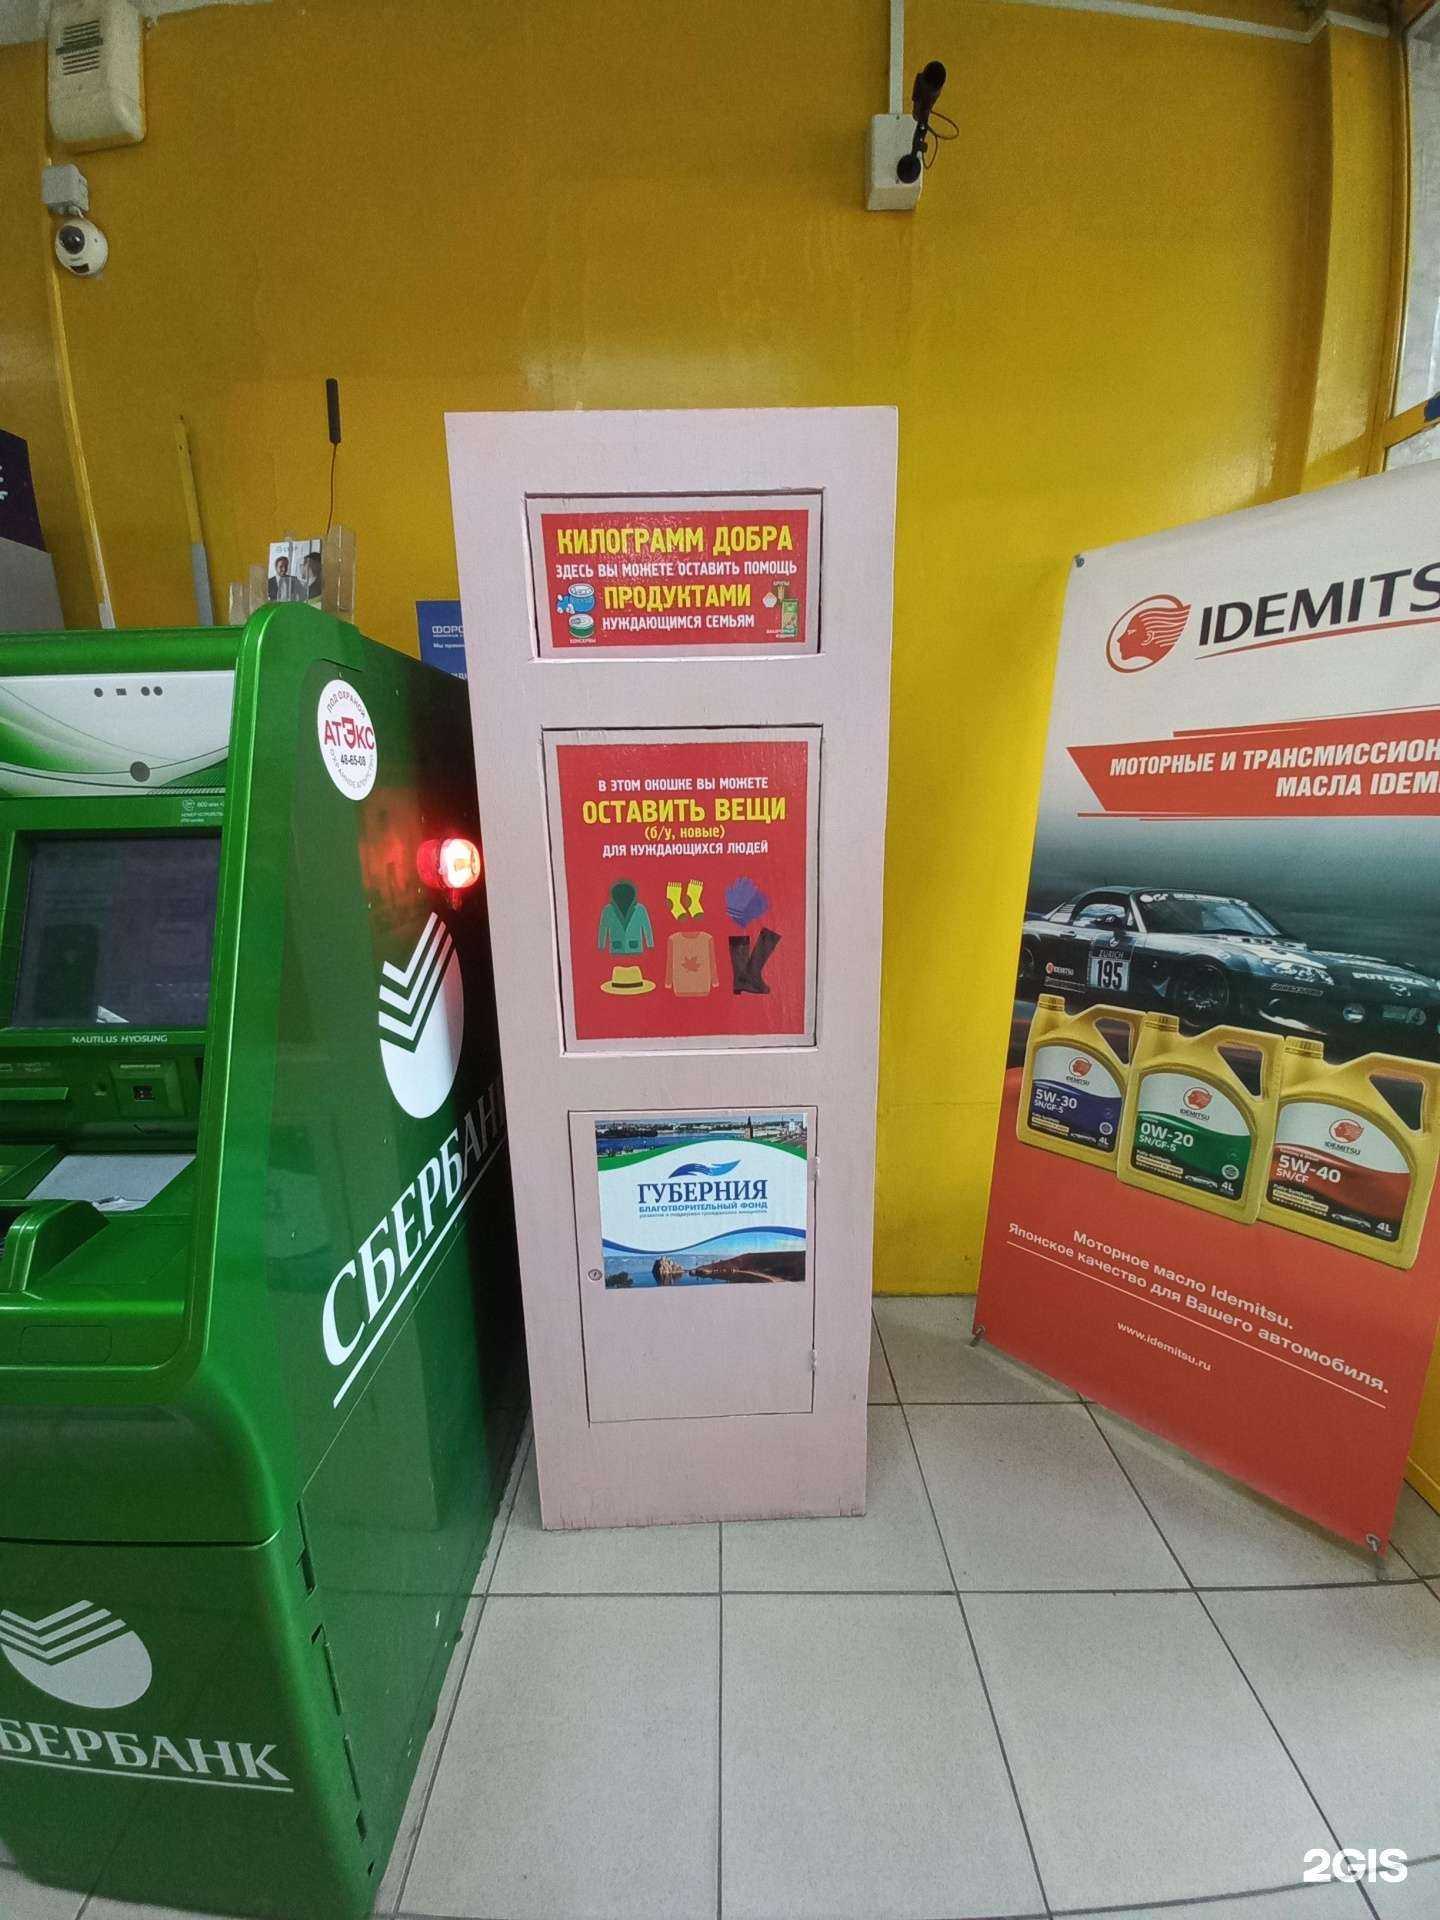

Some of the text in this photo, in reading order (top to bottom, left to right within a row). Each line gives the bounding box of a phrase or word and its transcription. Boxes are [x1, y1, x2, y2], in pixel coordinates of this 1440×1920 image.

[557, 525, 793, 556] КИЛОГРАММ ДОБРА
[556, 560, 798, 579] ЗДЕСЬ ВЫ МОЖЕТЕ ОСТАВИТЬ ПОМОЩЬ
[604, 584, 751, 612] ПРОДУКТАМИ
[1199, 562, 1440, 647] IDEMITS
[602, 614, 755, 632] НУЖДАЮЩИМСЯ СЕМЬЯМ
[323, 716, 375, 751] АТЭКС
[1109, 739, 1440, 777] МОТОРНЫЕ И ТРАНСМИССИОН
[598, 777, 769, 792] В ЭТОМ ОКОШКЕ ВЫ МОЖЕТЕ
[1276, 771, 1440, 797] МАСЛА IDEM
[582, 797, 786, 824] ОСТАВИТЬ ВЕЩИ
[644, 825, 725, 841] (б/у, новые)
[602, 840, 769, 858] ДЛЯ НУЖДАЮЩИХСЯ ЛЮДЕЙ
[1097, 960, 1123, 991] 195
[72, 1034, 168, 1044] NAUTILUS HYOSUNG
[1035, 1088, 1078, 1109] 5W-30
[1140, 1122, 1194, 1148] 0W-20
[1278, 1154, 1341, 1184] 5W-40
[637, 1179, 768, 1204] ГУБЕРНИЯ
[1221, 1180, 1235, 1192] 4L
[639, 1201, 768, 1213] БЛАГОТВОРИТЕЛЬНЫЙ ФОНД
[1376, 1221, 1393, 1233] 4L
[1073, 1230, 1293, 1331] Моторное масло Idemitsu.
[1008, 1222, 1389, 1393] Японское качество для Вашего автомобиля.
[1117, 1321, 1211, 1372] www.idemitsu.ru
